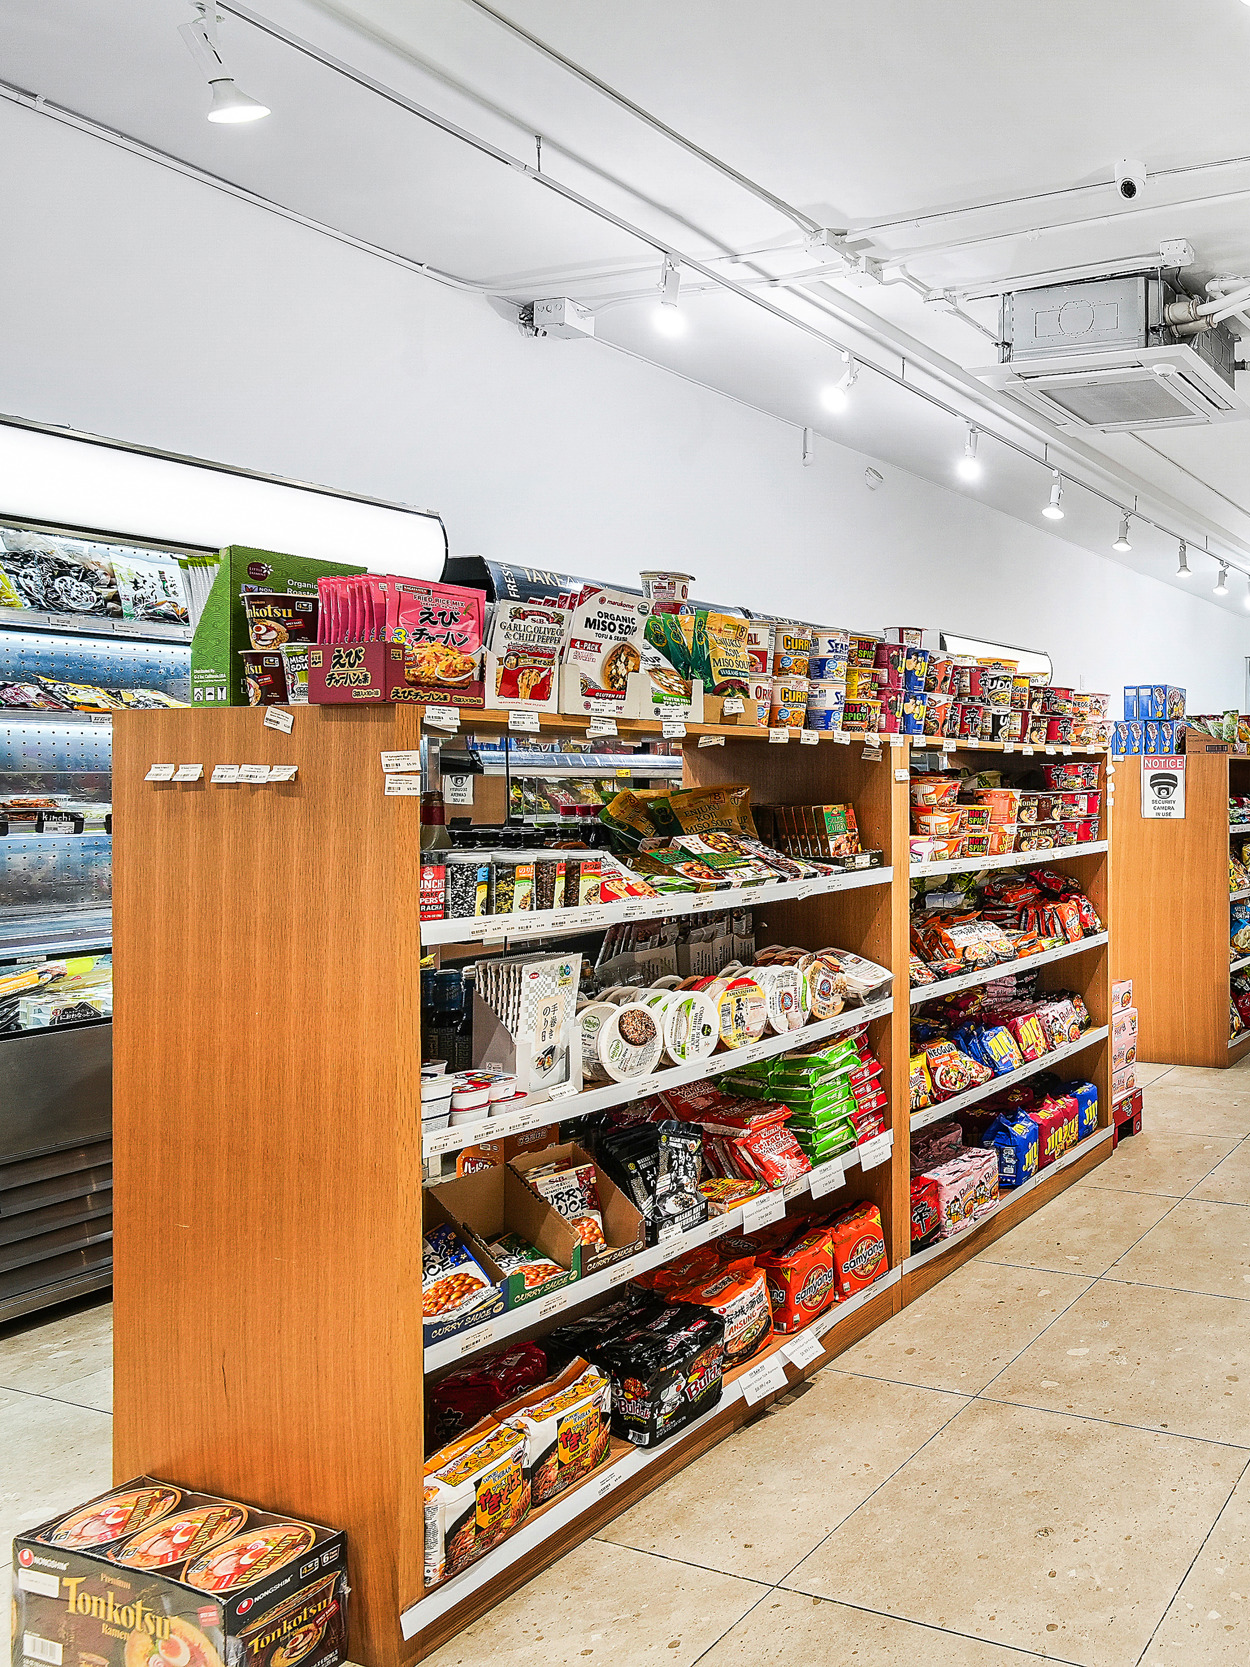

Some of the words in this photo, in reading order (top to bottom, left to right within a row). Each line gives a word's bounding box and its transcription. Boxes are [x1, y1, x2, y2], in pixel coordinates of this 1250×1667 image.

[287, 579, 319, 589] Organic
[506, 563, 521, 598] FRESH
[520, 567, 563, 588] TAKE
[246, 605, 293, 618] nkotsu
[607, 600, 634, 610] marukome
[418, 606, 461, 627] えび
[584, 617, 617, 633] MISO
[597, 611, 636, 624] ORGANIC
[411, 627, 469, 648] チャーハン
[504, 631, 512, 640] &
[512, 632, 536, 642] CHILI
[574, 641, 599, 652] 4-PACK
[783, 635, 810, 650] CURR
[858, 641, 872, 650] HOT
[332, 646, 366, 669] えび
[713, 658, 734, 668] MISO
[735, 660, 749, 669] SOU
[781, 689, 808, 702] CURR
[844, 704, 861, 714] HOT
[844, 713, 867, 722] SPICY
[1144, 758, 1183, 769] NOTICE
[685, 822, 710, 835] MISO
[711, 817, 734, 828] SOUP
[927, 1043, 956, 1059] NEOGUR
[544, 1186, 586, 1205] URRY
[559, 1199, 590, 1215] UCE
[587, 1254, 611, 1271] CURRY
[611, 1247, 634, 1261] SAUCE
[842, 1239, 885, 1273] samyang
[513, 1286, 545, 1304] CURRY
[543, 1278, 568, 1292] SAUCE
[795, 1268, 834, 1305] samyang
[431, 1320, 463, 1339] CURRY
[464, 1309, 492, 1325] SAUCE
[728, 1311, 757, 1337] ANSUNG
[685, 1363, 722, 1402] Bulda
[618, 1398, 650, 1420] Buldak
[559, 1412, 599, 1453] やきそば
[478, 1470, 521, 1515] やきそば
[120, 1489, 162, 1535] Tonkotsu
[181, 1508, 231, 1557] Tonkotsu
[236, 1532, 305, 1584] Tonkotsu
[100, 1573, 131, 1590] Premium
[255, 1574, 293, 1603] NONGSHIM
[62, 1577, 170, 1640] Tonkotsu
[102, 1623, 130, 1641] Ramen
[248, 1598, 332, 1657] Tonkotsu
